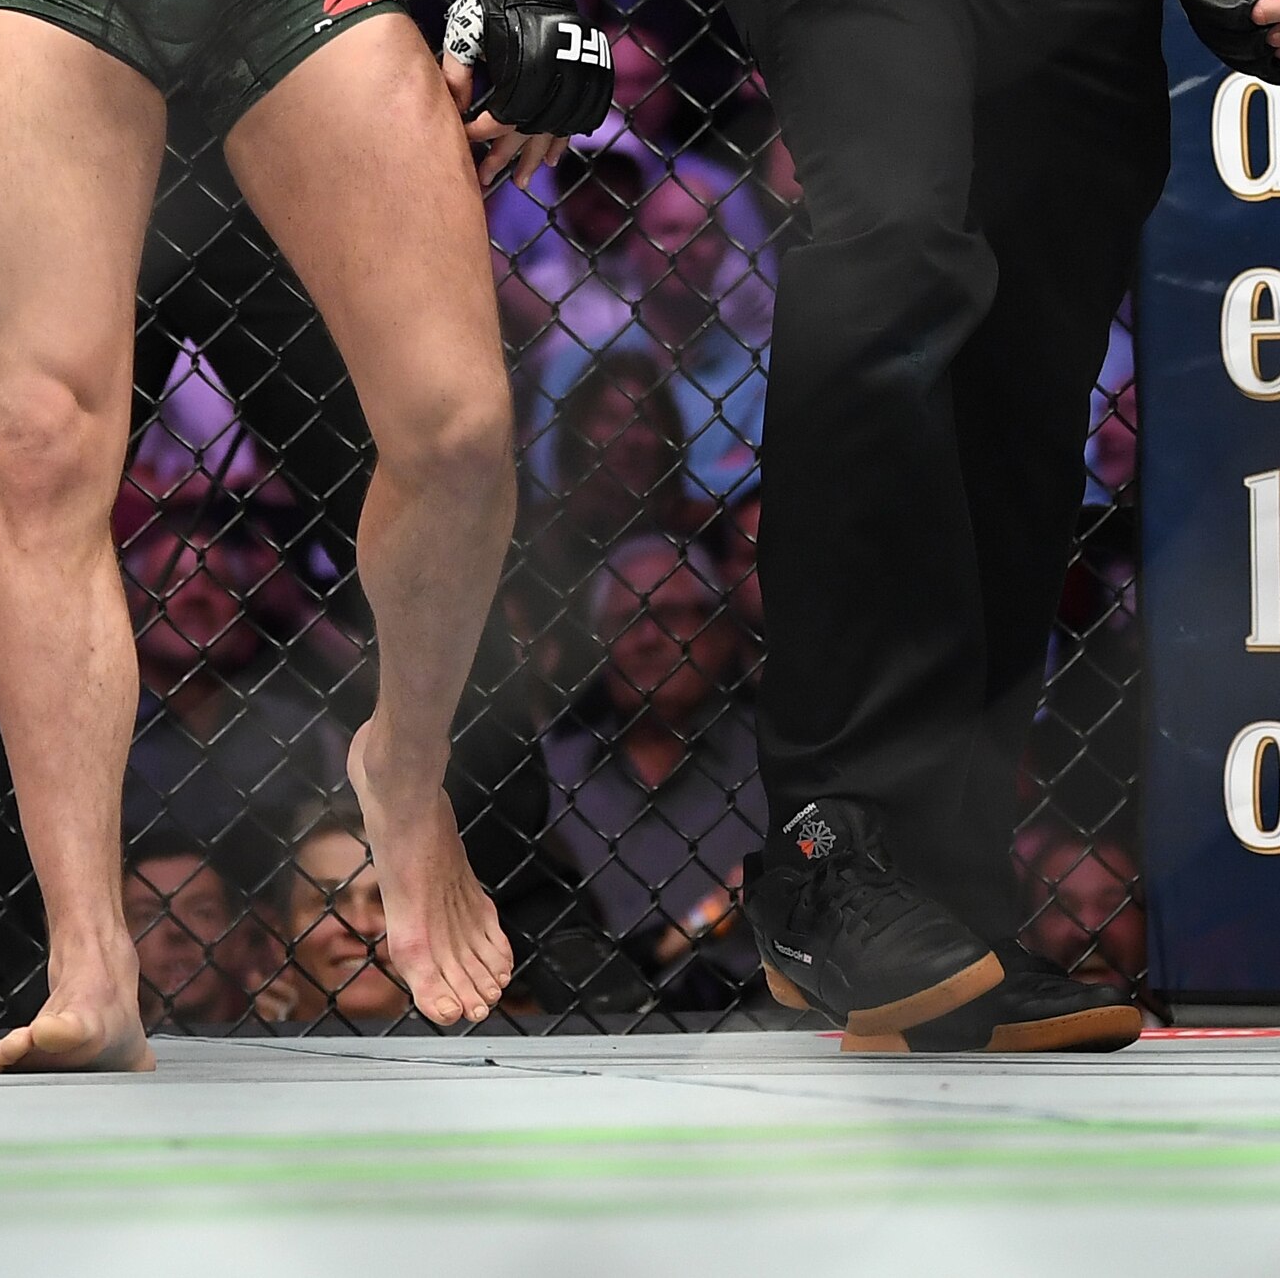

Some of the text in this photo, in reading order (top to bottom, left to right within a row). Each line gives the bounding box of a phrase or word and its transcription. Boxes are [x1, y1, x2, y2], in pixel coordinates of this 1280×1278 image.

[556, 22, 611, 69] UFC
[782, 802, 817, 834] Reebok
[773, 939, 803, 961] Reebok
